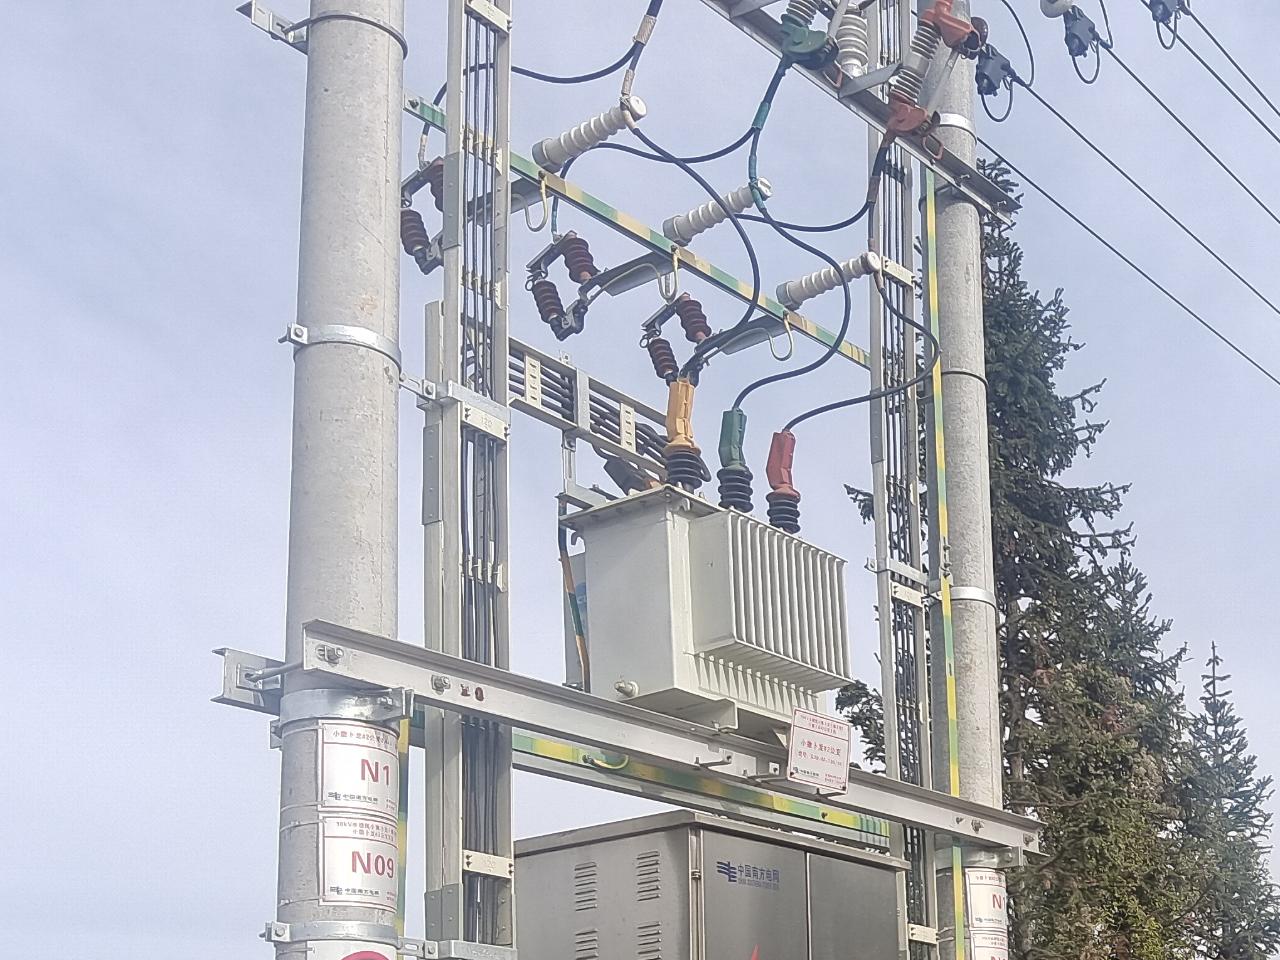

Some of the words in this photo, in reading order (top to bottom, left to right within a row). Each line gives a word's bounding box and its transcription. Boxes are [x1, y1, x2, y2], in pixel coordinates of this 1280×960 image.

[361, 759, 389, 785] N1
[352, 851, 394, 878] N09
[738, 865, 780, 883] 中国南方电网
